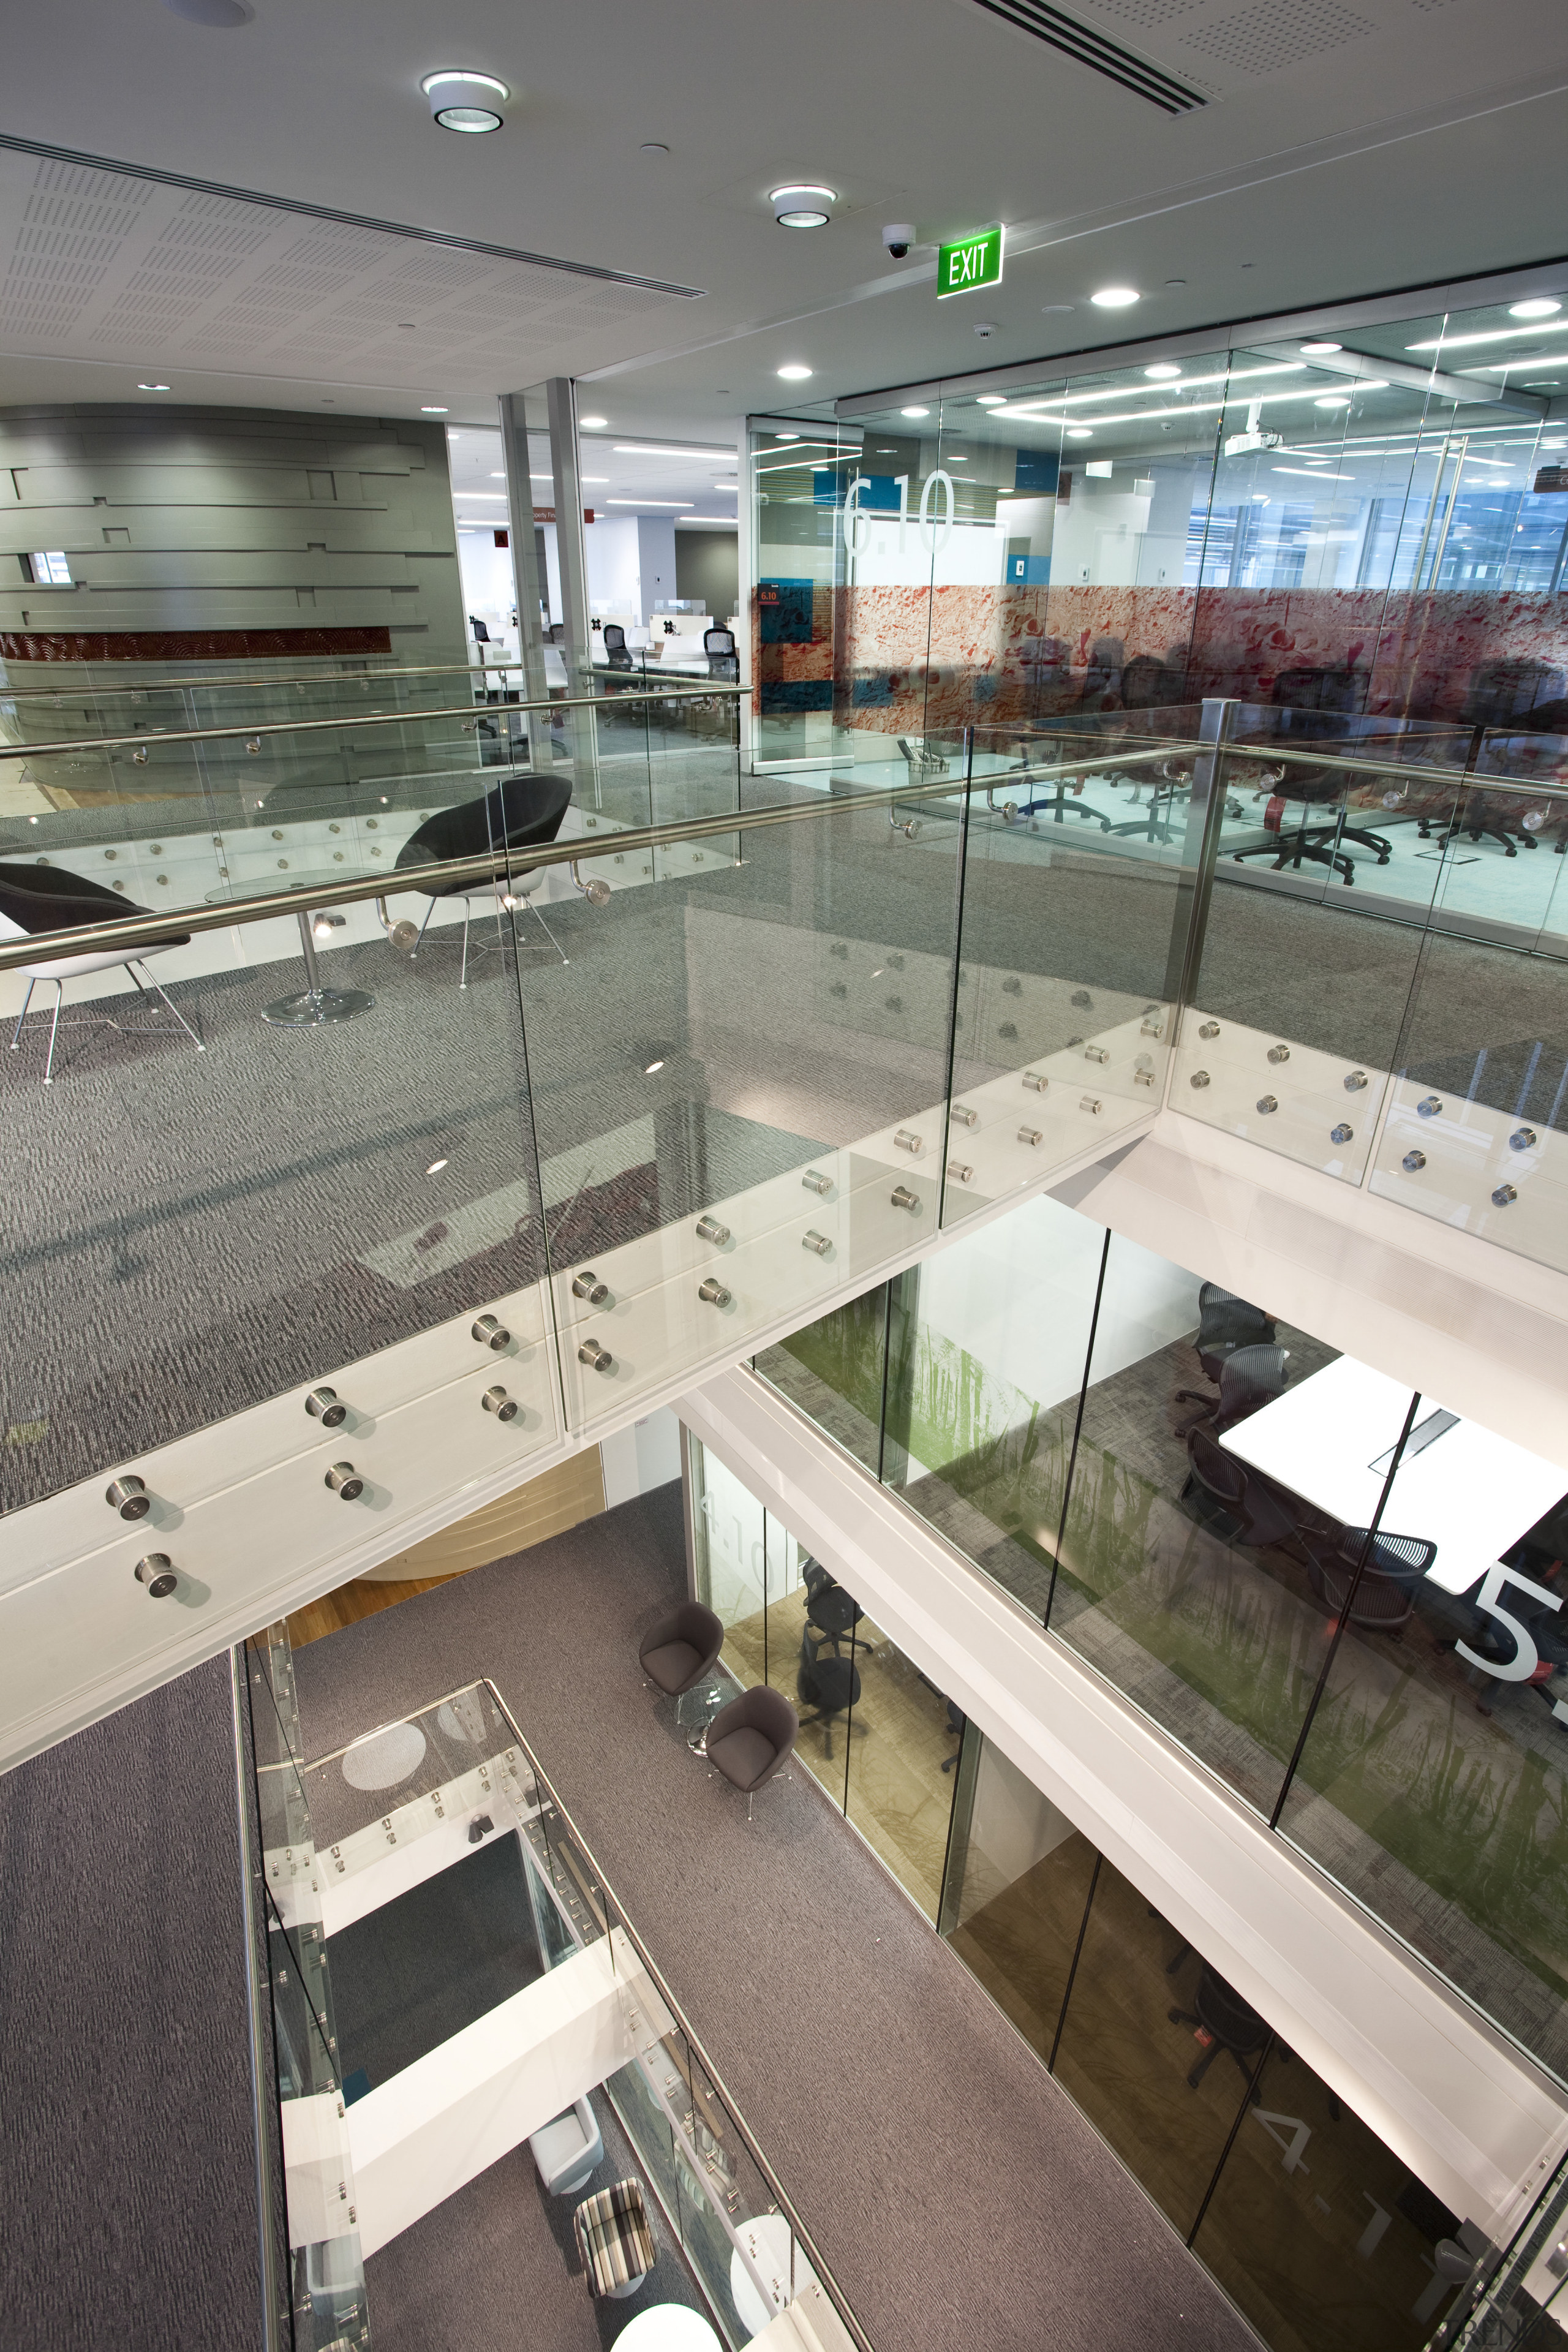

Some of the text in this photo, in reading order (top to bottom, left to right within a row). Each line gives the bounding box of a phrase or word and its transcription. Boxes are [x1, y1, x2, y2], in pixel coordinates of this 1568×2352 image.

[949, 242, 989, 286] EXIT
[843, 469, 955, 558] 6.10
[498, 535, 505, 545] A
[761, 592, 777, 600] 6.10
[699, 1490, 775, 1593] 4.10
